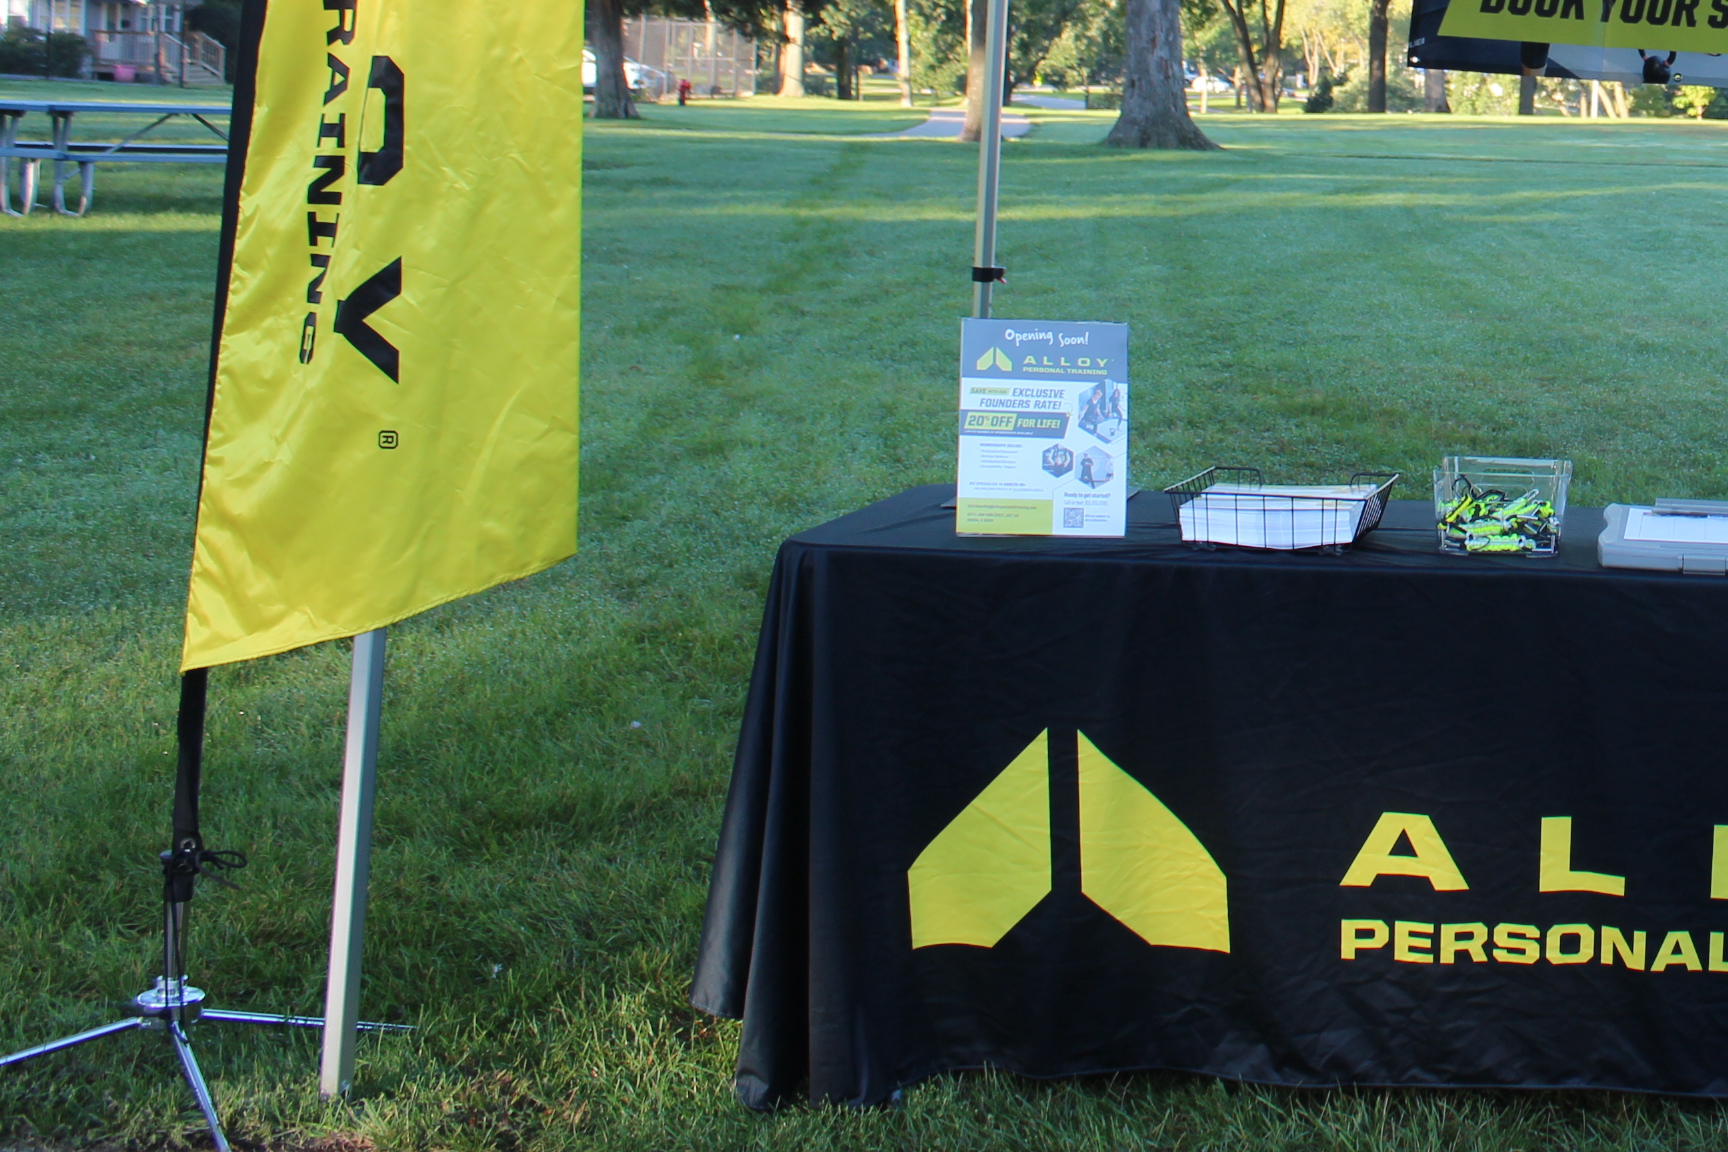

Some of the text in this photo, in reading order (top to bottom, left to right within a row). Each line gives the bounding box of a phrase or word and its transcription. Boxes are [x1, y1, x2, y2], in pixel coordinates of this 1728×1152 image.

[1005, 328, 1089, 347] Opening Soon!
[1023, 355, 1108, 367] ALLOY
[1023, 366, 1065, 374] PERSONAL
[1012, 387, 1066, 398] EXCLUSIVE
[979, 398, 1062, 410] FOUNDERS RATE!
[990, 415, 1014, 428] OFF
[1016, 418, 1036, 428] FOR
[1037, 419, 1061, 428] LIFE!
